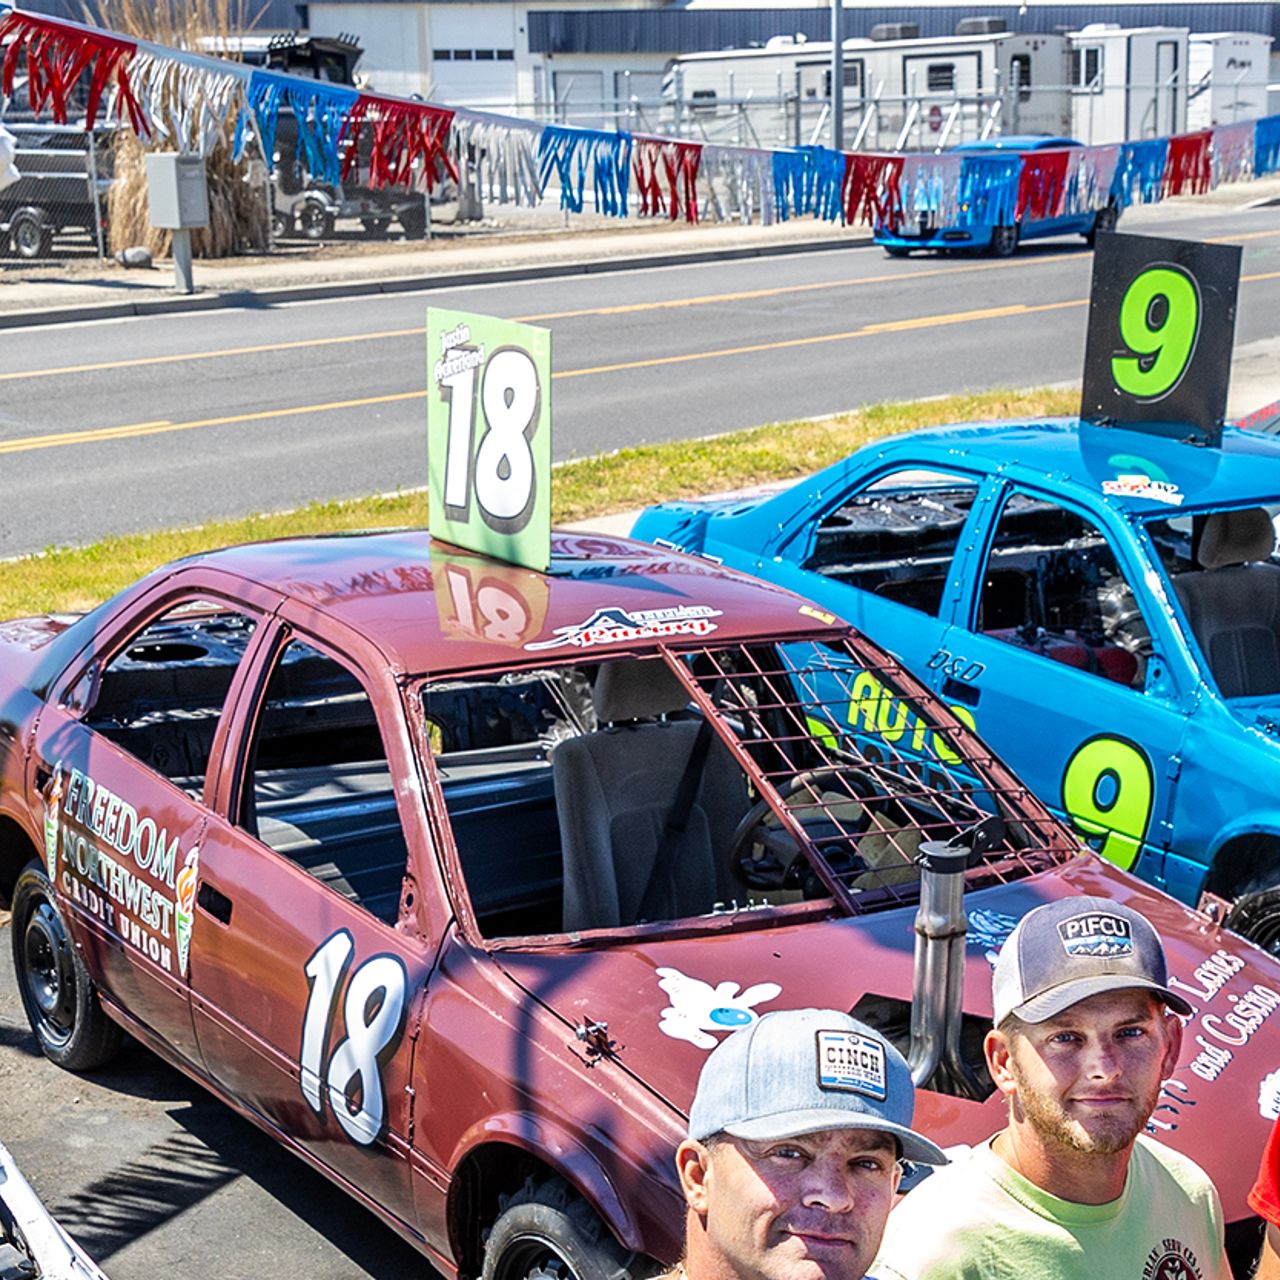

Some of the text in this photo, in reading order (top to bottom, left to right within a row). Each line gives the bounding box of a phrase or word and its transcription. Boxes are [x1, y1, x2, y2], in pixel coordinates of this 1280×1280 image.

[1111, 262, 1202, 402] 9
[438, 344, 542, 535] 18
[925, 650, 986, 682] D&D
[64, 768, 182, 891] FREEDOM
[1060, 732, 1157, 873] 9
[61, 826, 174, 940] NORTHWEST
[120, 912, 172, 972] UNION
[1066, 917, 1126, 939] P1FCU
[1167, 948, 1247, 1004] Lanes
[300, 927, 410, 1154] 18
[826, 1046, 880, 1074] CINCH
[1190, 1034, 1234, 1082] and
